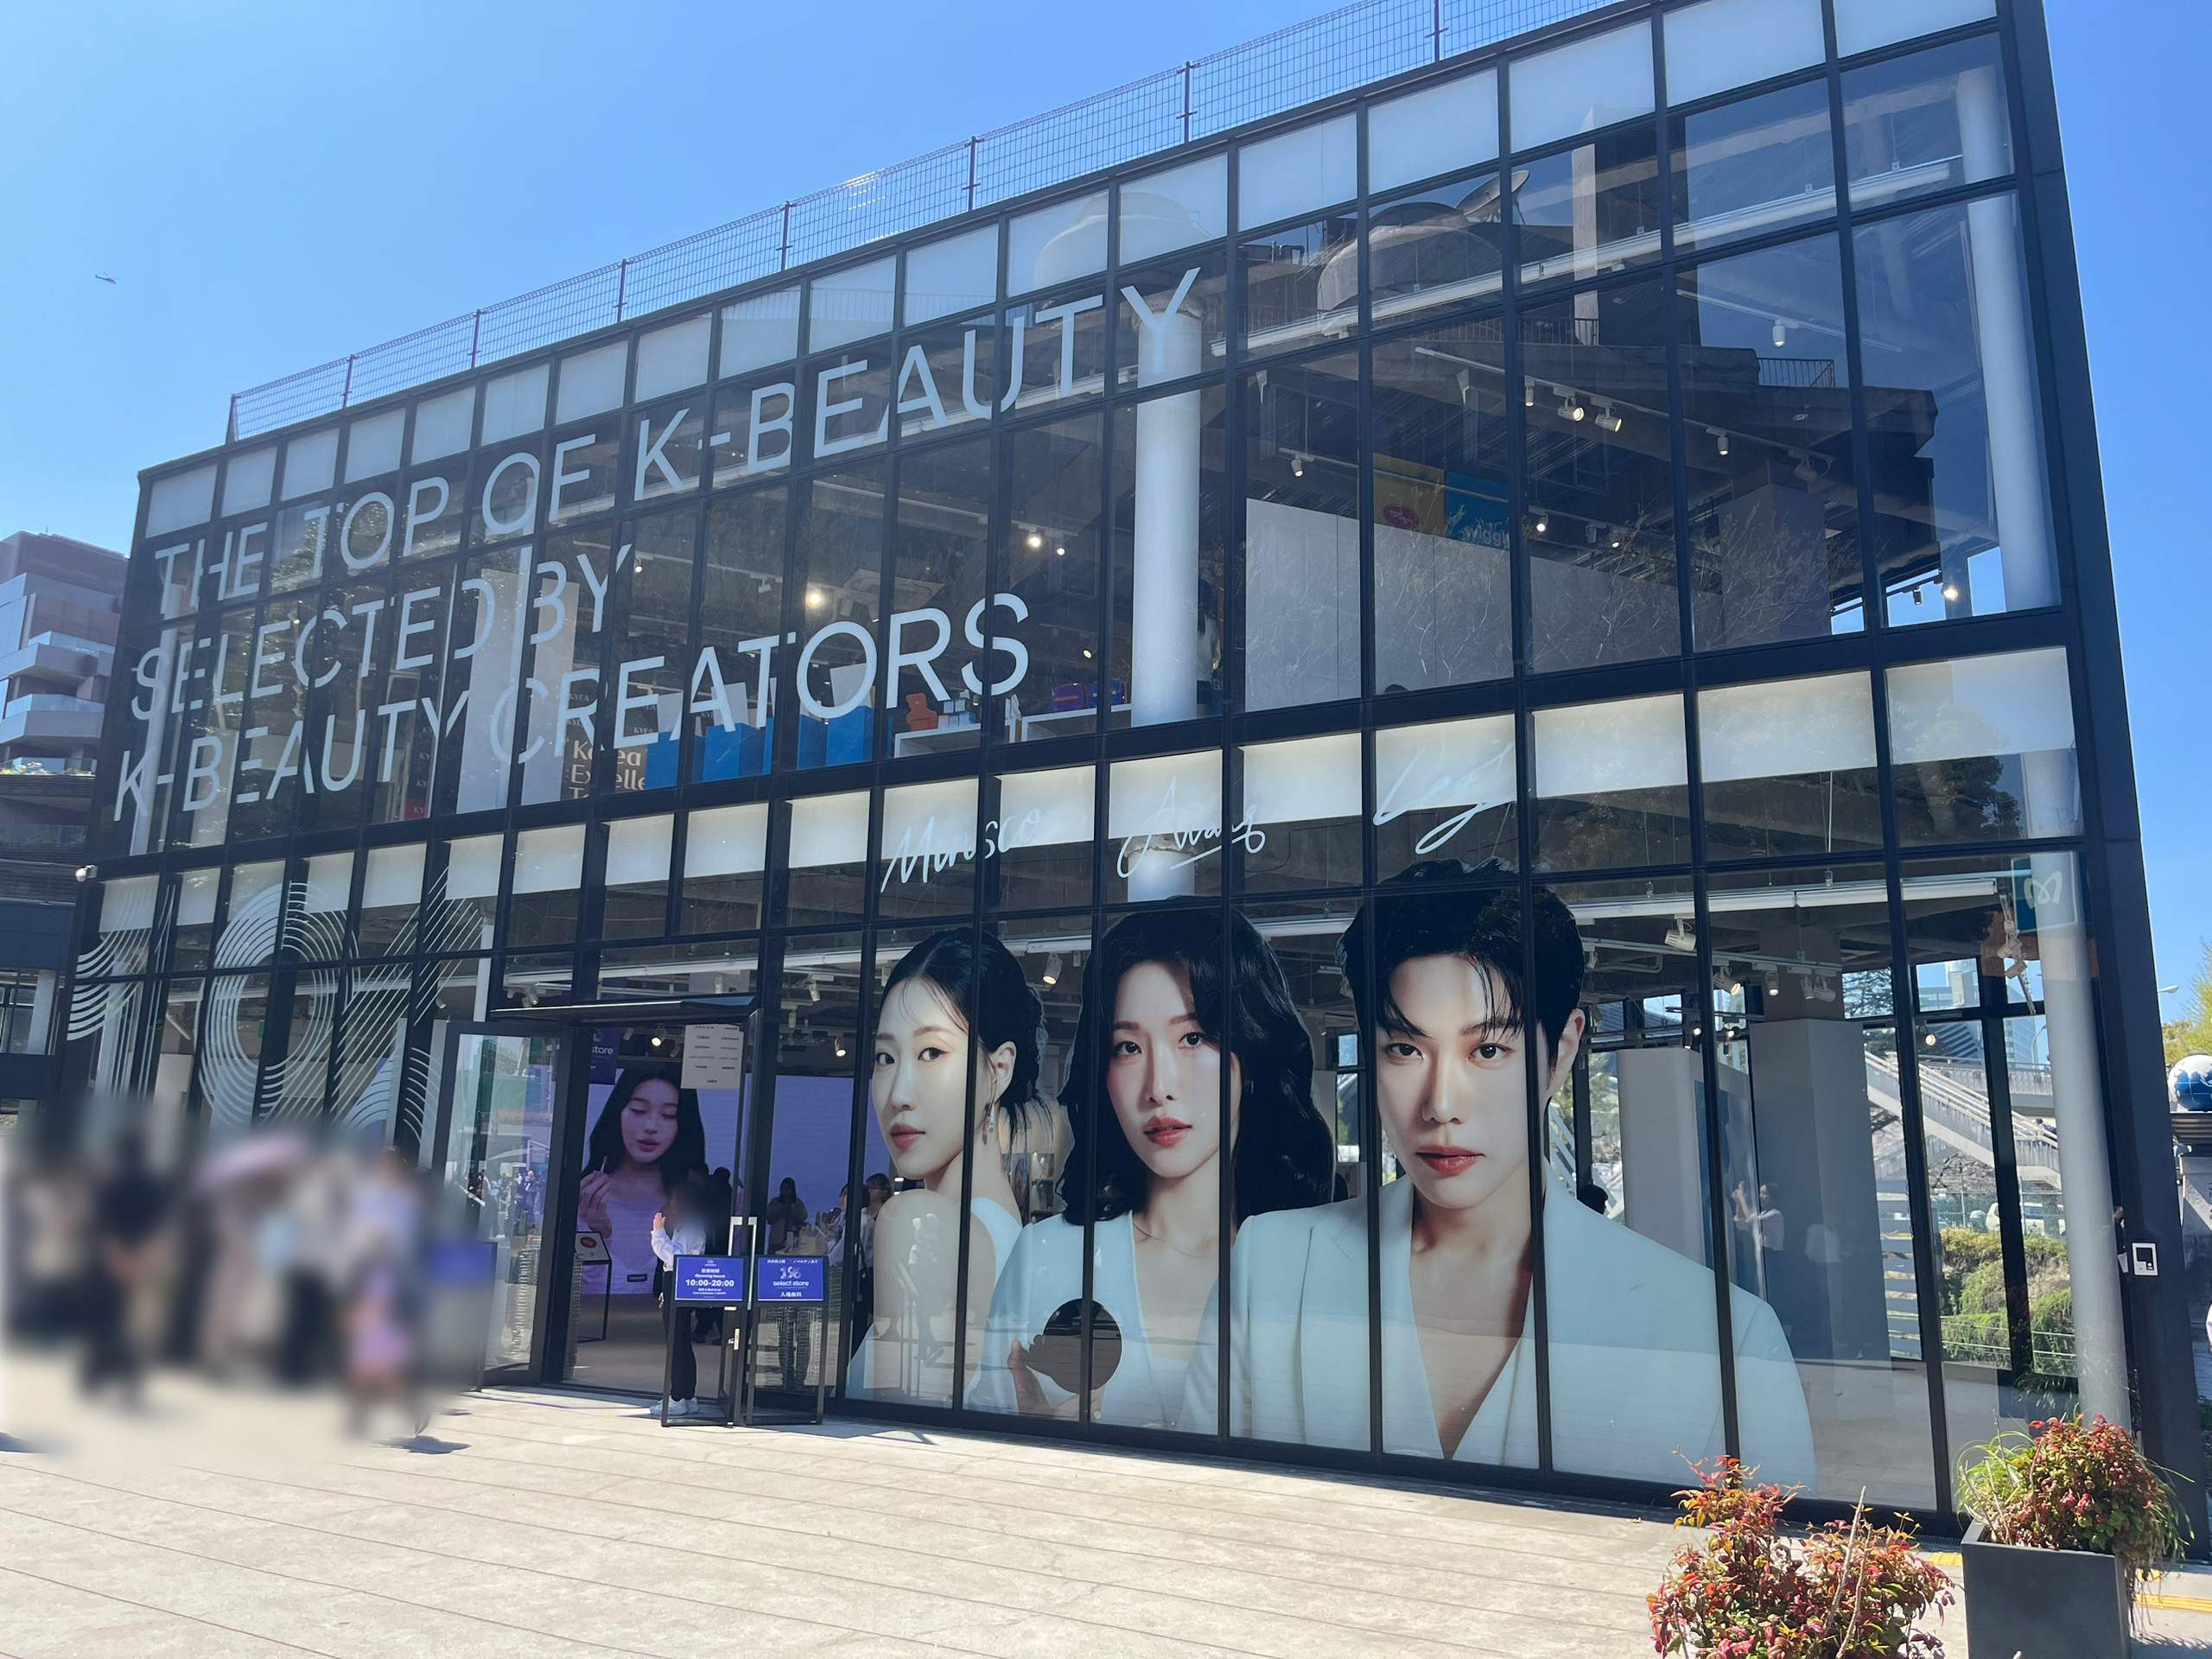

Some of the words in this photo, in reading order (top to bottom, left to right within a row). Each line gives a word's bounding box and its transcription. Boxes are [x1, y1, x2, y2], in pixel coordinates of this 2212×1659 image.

[154, 521, 268, 621] THE
[303, 476, 450, 580] TOP
[481, 433, 597, 537] OF
[633, 266, 1201, 501] K-BEAUTY
[113, 690, 469, 823] K-BEAUTY
[489, 592, 1029, 765] CREATORS
[131, 578, 496, 721] SELECTED
[519, 543, 633, 645] BY
[685, 1279, 734, 1287] 10:00-20:00
